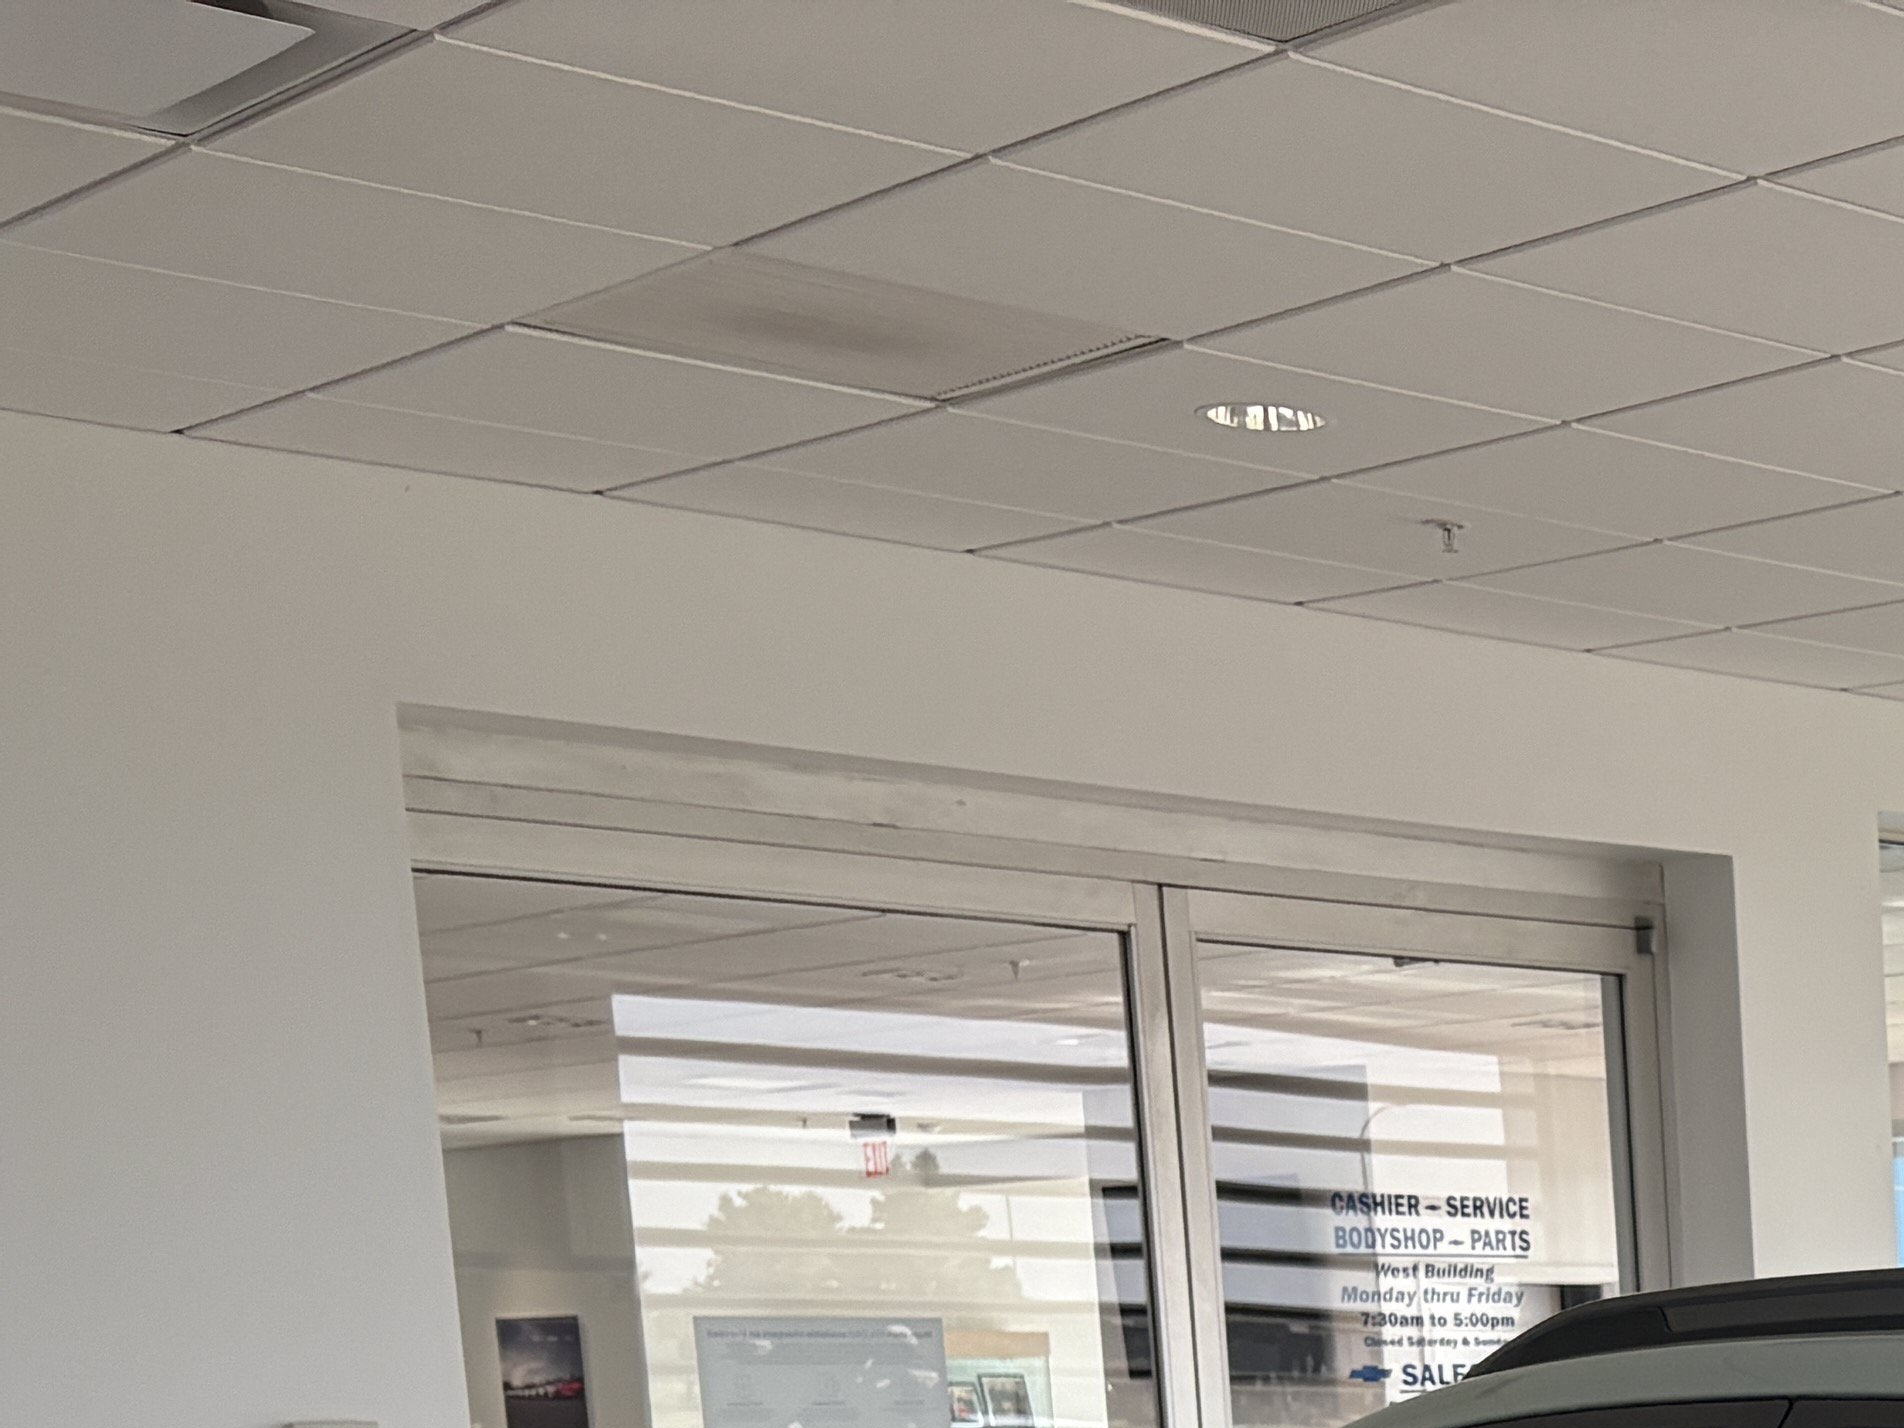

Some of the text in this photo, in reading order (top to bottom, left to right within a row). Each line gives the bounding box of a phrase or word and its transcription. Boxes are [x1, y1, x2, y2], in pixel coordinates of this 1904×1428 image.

[1331, 1191, 1420, 1216] CASHIER
[1446, 1195, 1530, 1219] SERVICE
[1334, 1226, 1444, 1250] BODYSHOP
[1470, 1229, 1531, 1252] PARTS
[1377, 1262, 1495, 1284] West Building
[1341, 1286, 1524, 1307] Monday thru Friday
[1360, 1312, 1515, 1331] 7:30am to 5:00pm
[1402, 1363, 1468, 1386] SALE
